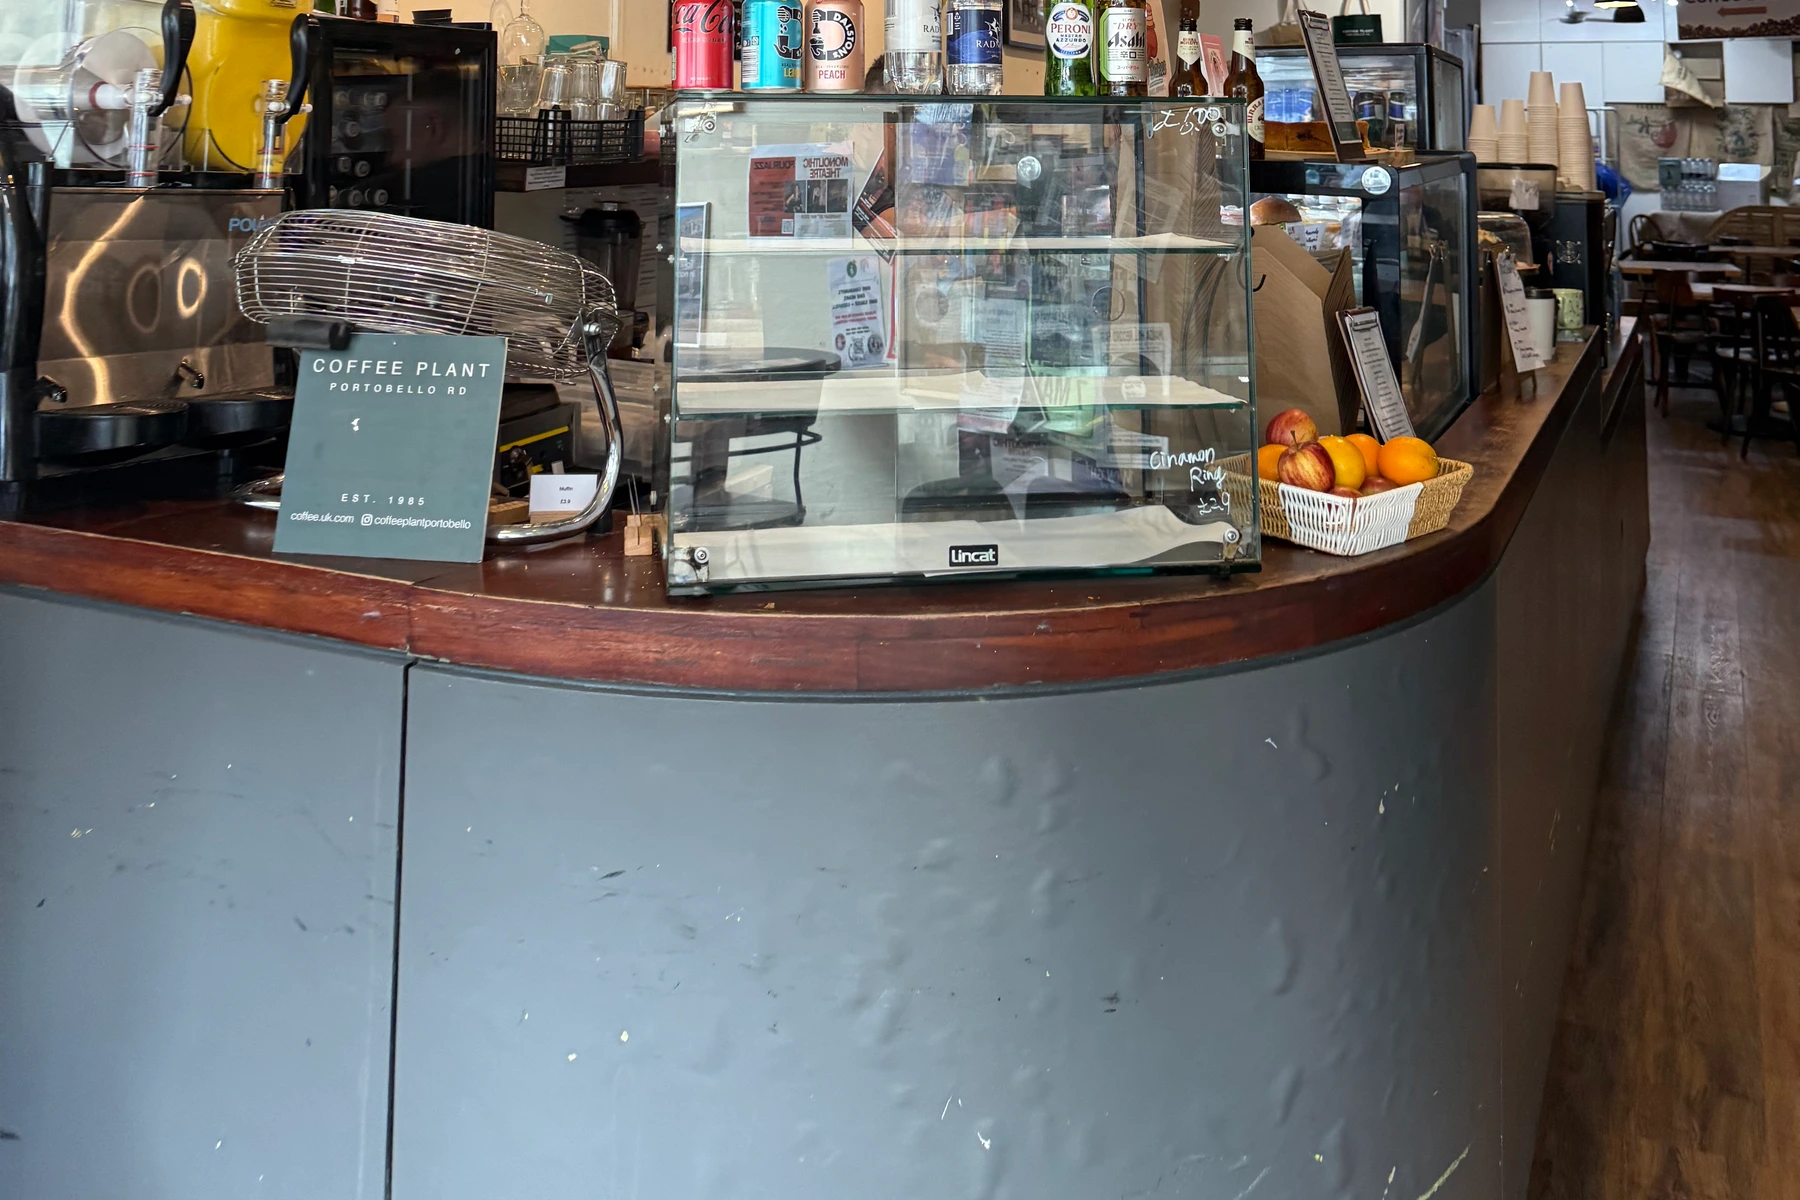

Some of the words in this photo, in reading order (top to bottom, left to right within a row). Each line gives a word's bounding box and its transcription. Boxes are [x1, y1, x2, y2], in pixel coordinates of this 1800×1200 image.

[1050, 23, 1091, 35] PERONI
[1107, 31, 1145, 48] Asahi
[818, 69, 846, 80] PEACH
[313, 358, 404, 376] COFFEE
[416, 361, 491, 378] PLANT
[329, 382, 436, 395] PORTOBELLO
[447, 386, 467, 396] RD
[1190, 466, 1226, 492] Ring
[341, 493, 376, 504] EST.
[388, 496, 425, 506] 1985
[290, 511, 354, 523] coffee.uk.com
[374, 516, 471, 530] coffeeplantportobello
[951, 548, 996, 563] Lincat
